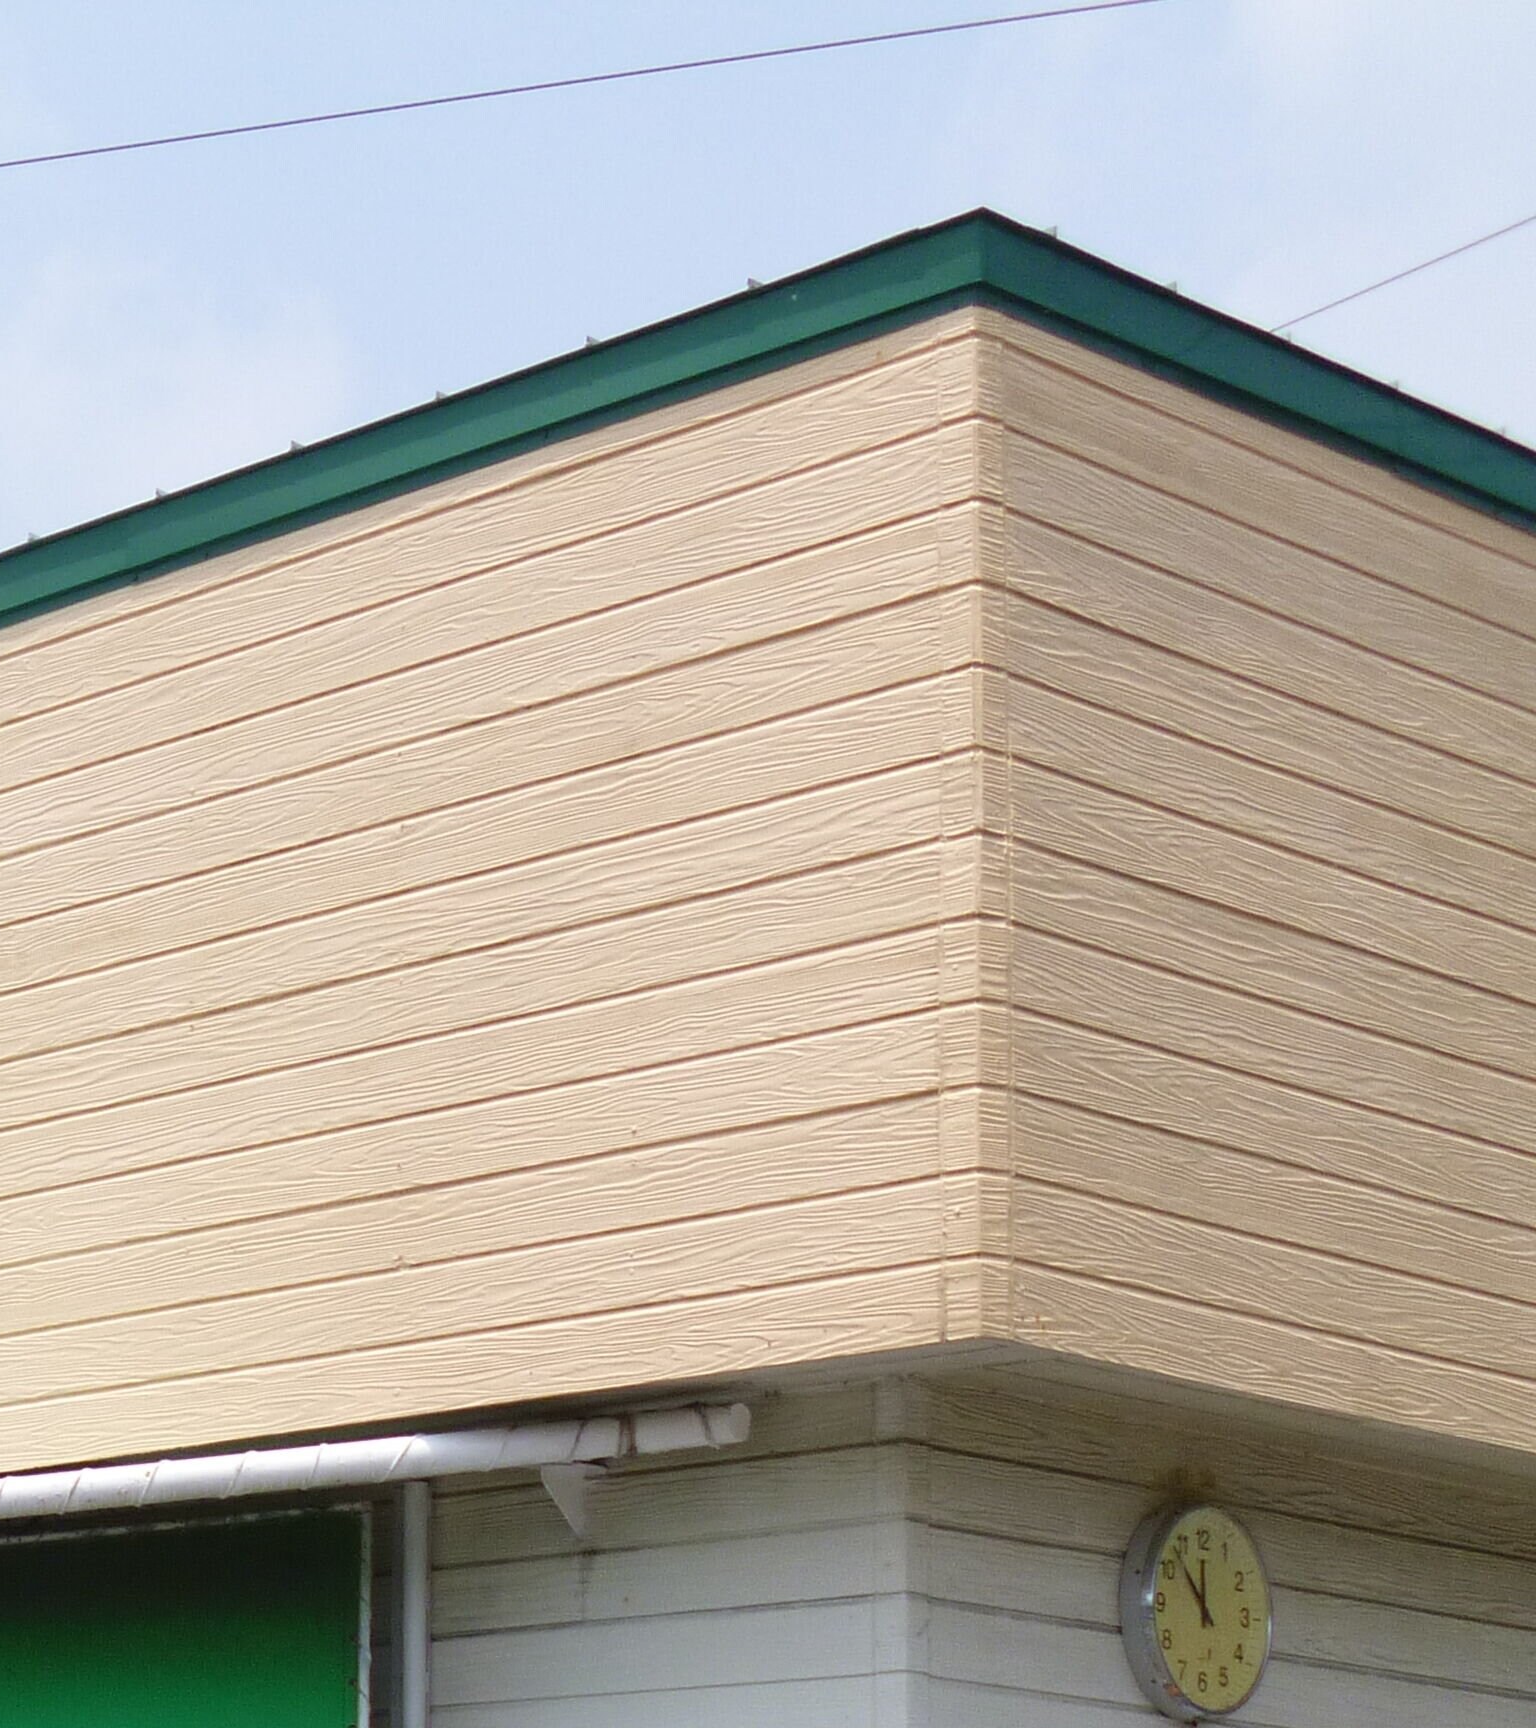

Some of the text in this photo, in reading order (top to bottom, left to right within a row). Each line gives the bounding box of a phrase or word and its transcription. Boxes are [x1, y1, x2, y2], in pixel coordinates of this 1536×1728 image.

[1196, 1530, 1210, 1550] 12
[1234, 1571, 1244, 1592] 2
[1156, 1592, 1166, 1612] 9
[1240, 1608, 1250, 1628] 3
[1162, 1629, 1172, 1650] 8
[1234, 1643, 1244, 1663] 4
[1197, 1672, 1208, 1692] 6
[1219, 1667, 1228, 1686] 5
